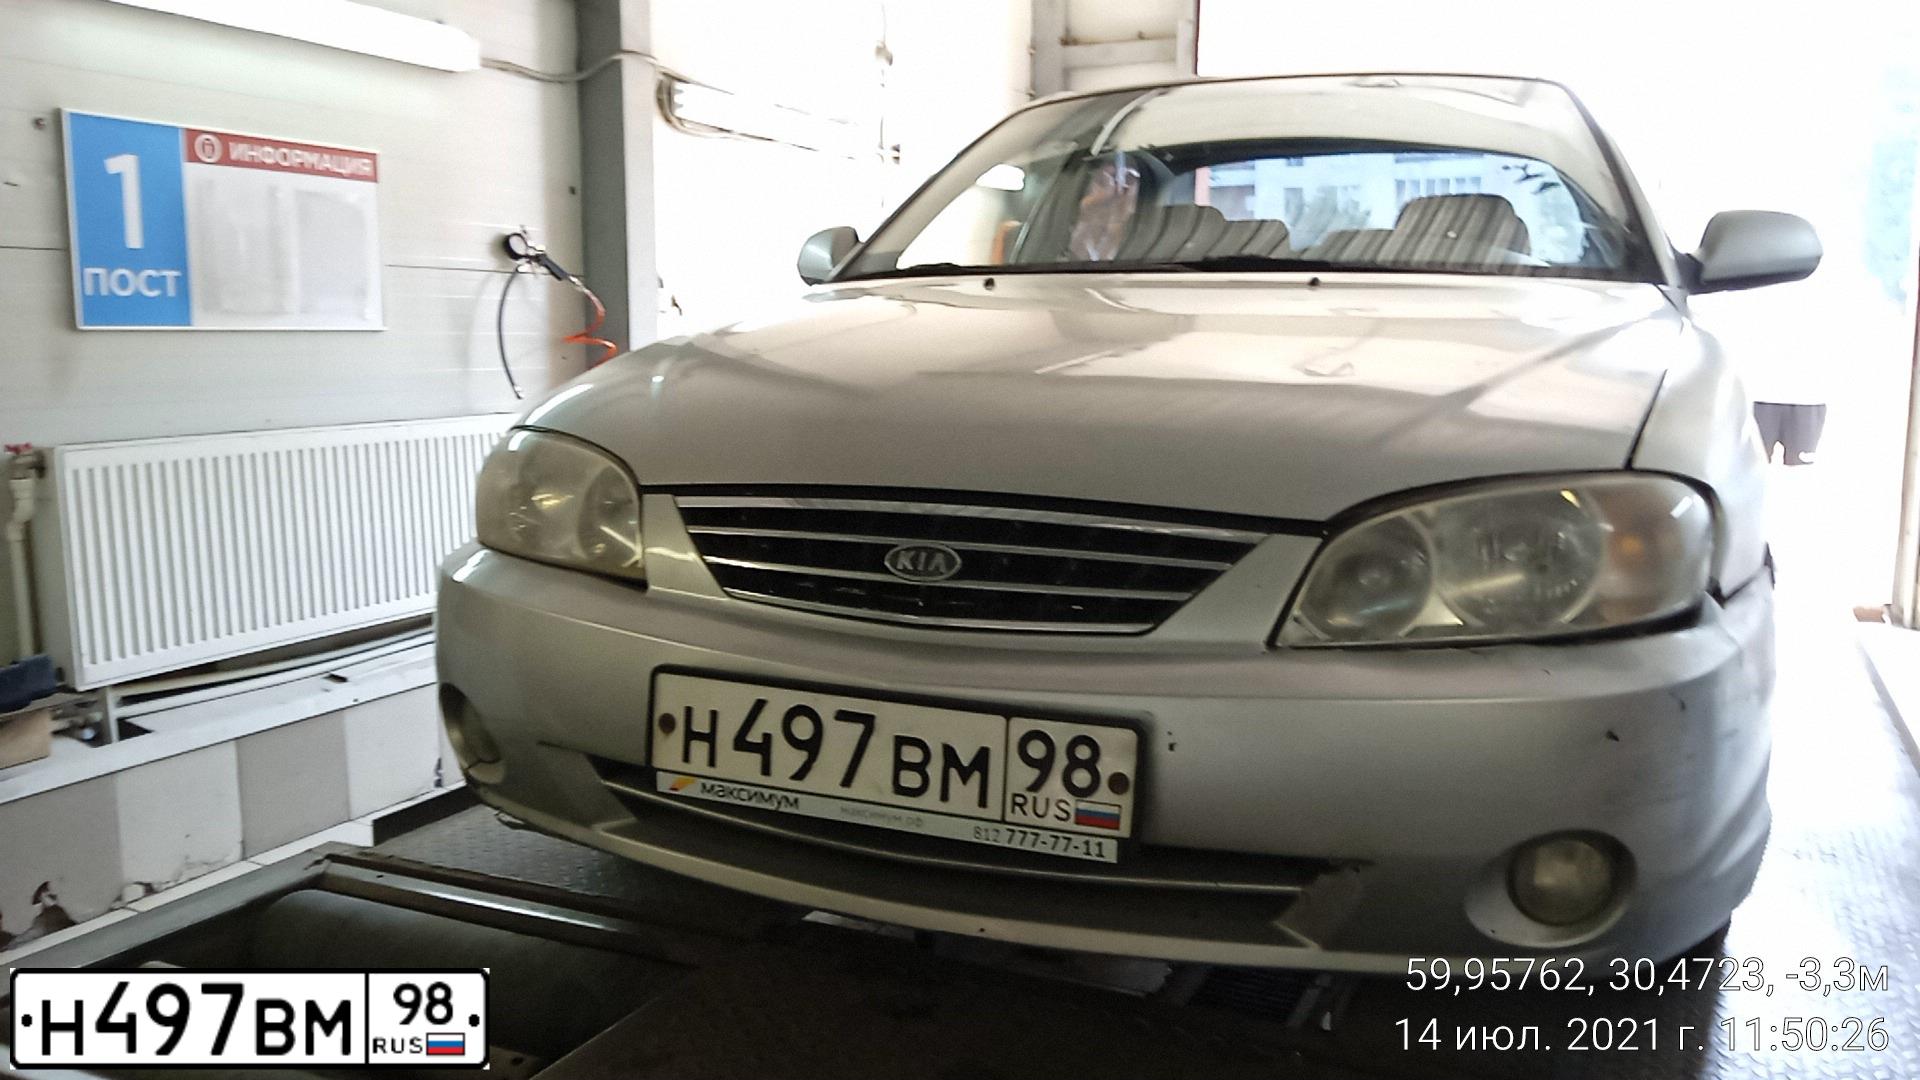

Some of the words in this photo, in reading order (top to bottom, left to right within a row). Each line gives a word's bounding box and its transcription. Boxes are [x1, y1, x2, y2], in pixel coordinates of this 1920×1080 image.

[227, 140, 374, 177] ИНФОРМАЦИЯ
[103, 153, 145, 249] 1
[82, 267, 181, 298] ПОСТ
[895, 550, 947, 574] KIA
[1016, 728, 1102, 798] 98
[700, 781, 800, 811] максимум
[1011, 792, 1072, 822] RUS
[1005, 827, 1106, 859] 777-77-11
